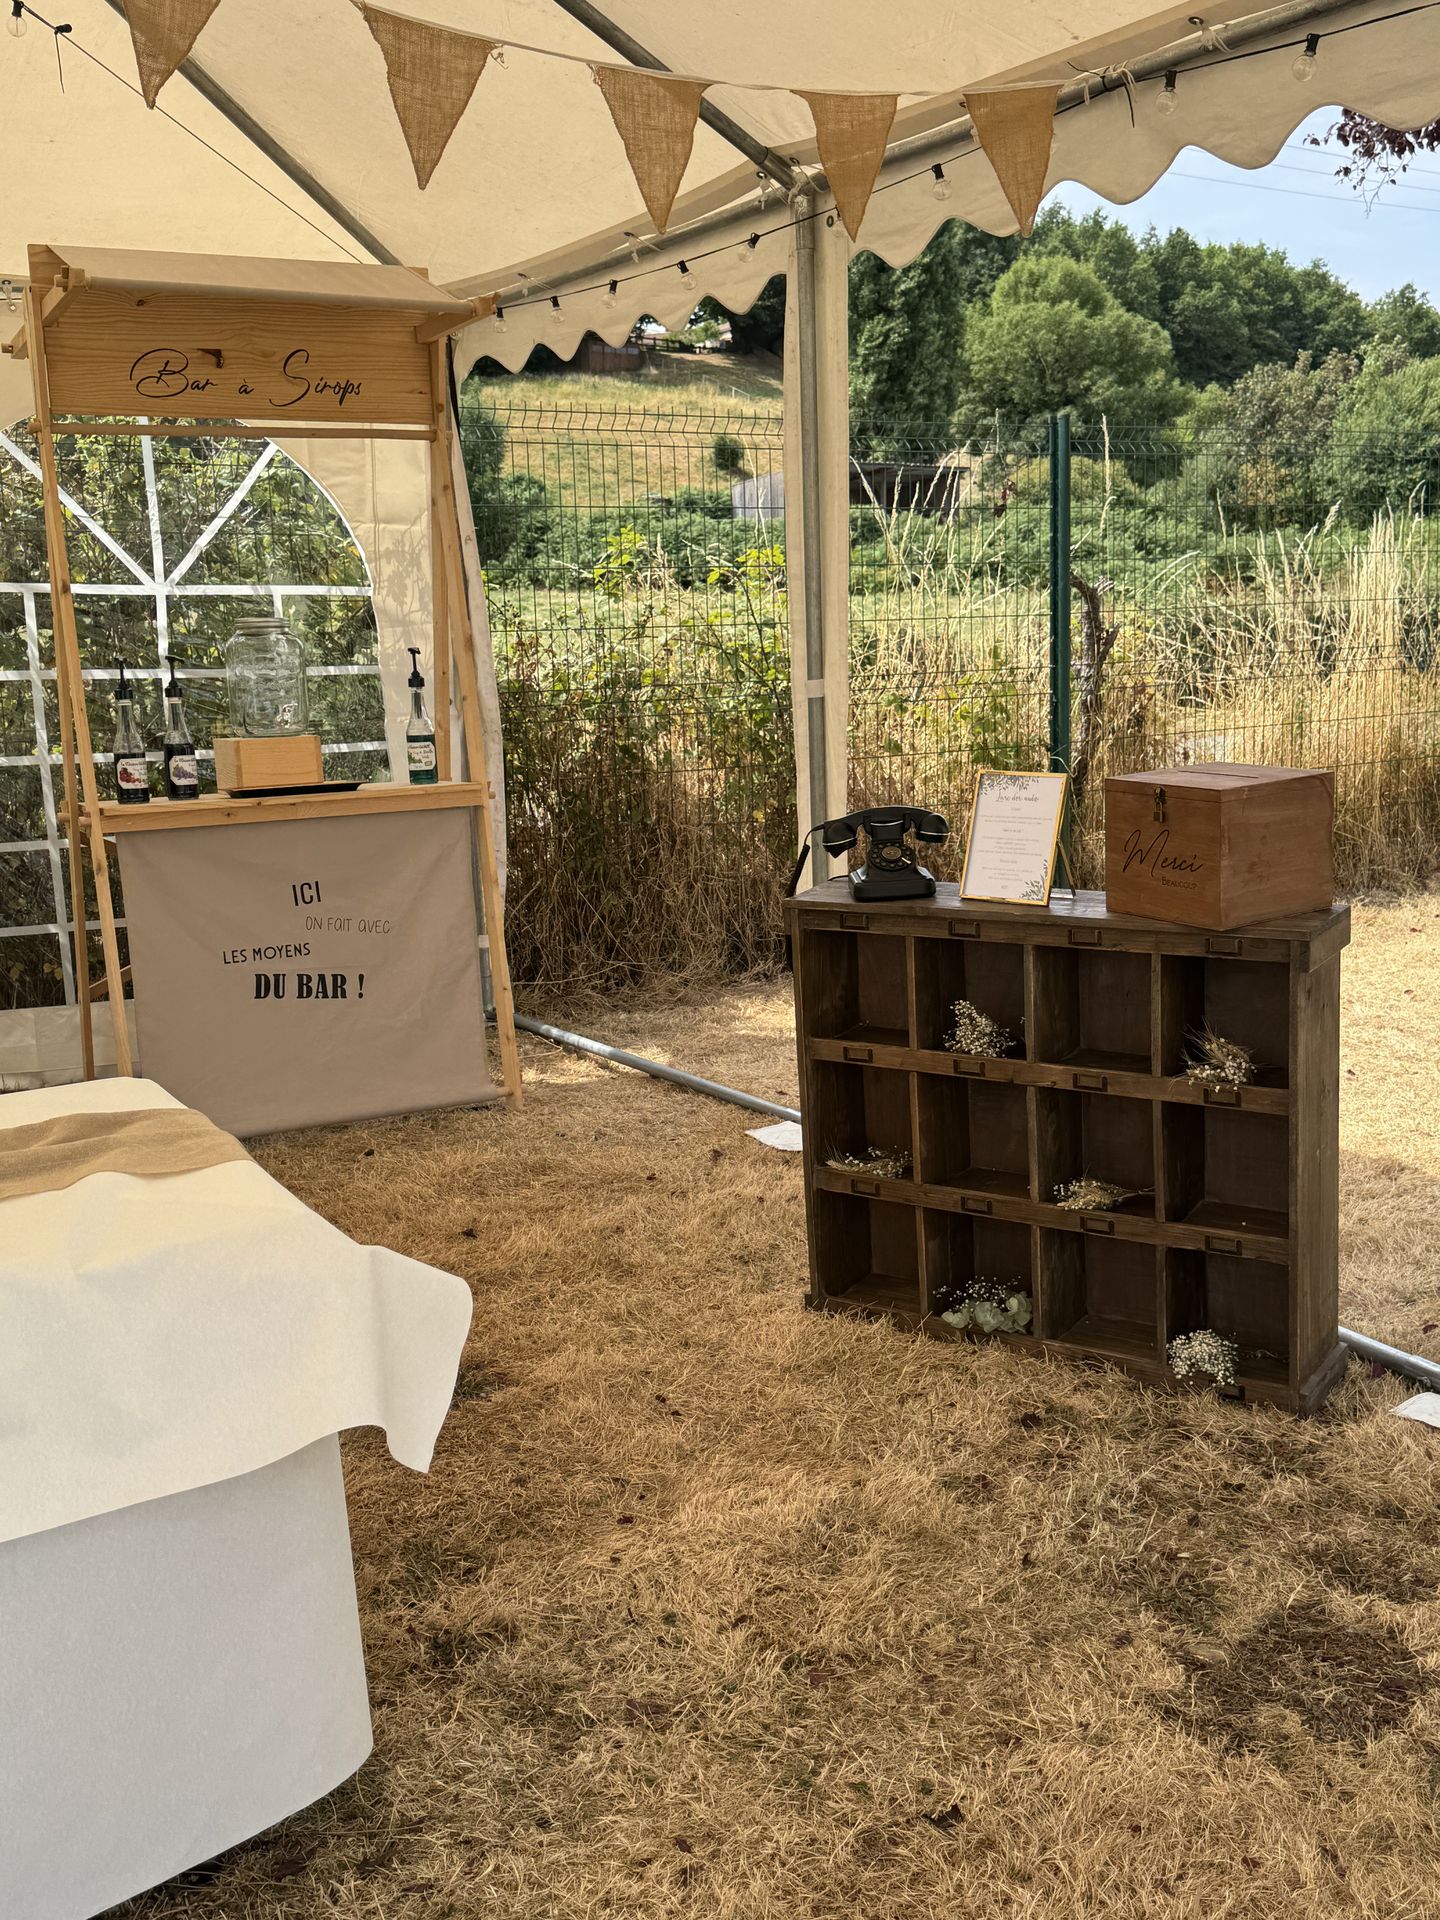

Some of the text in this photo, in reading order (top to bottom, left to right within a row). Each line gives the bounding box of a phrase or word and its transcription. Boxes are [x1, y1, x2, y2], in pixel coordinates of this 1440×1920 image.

[130, 348, 362, 407] Bar à Sirops
[1122, 829, 1204, 878] Merci
[292, 880, 322, 907] ICI
[305, 915, 323, 931] ON
[223, 942, 311, 965] LES MOYENS
[254, 973, 365, 999] DU BAR !
